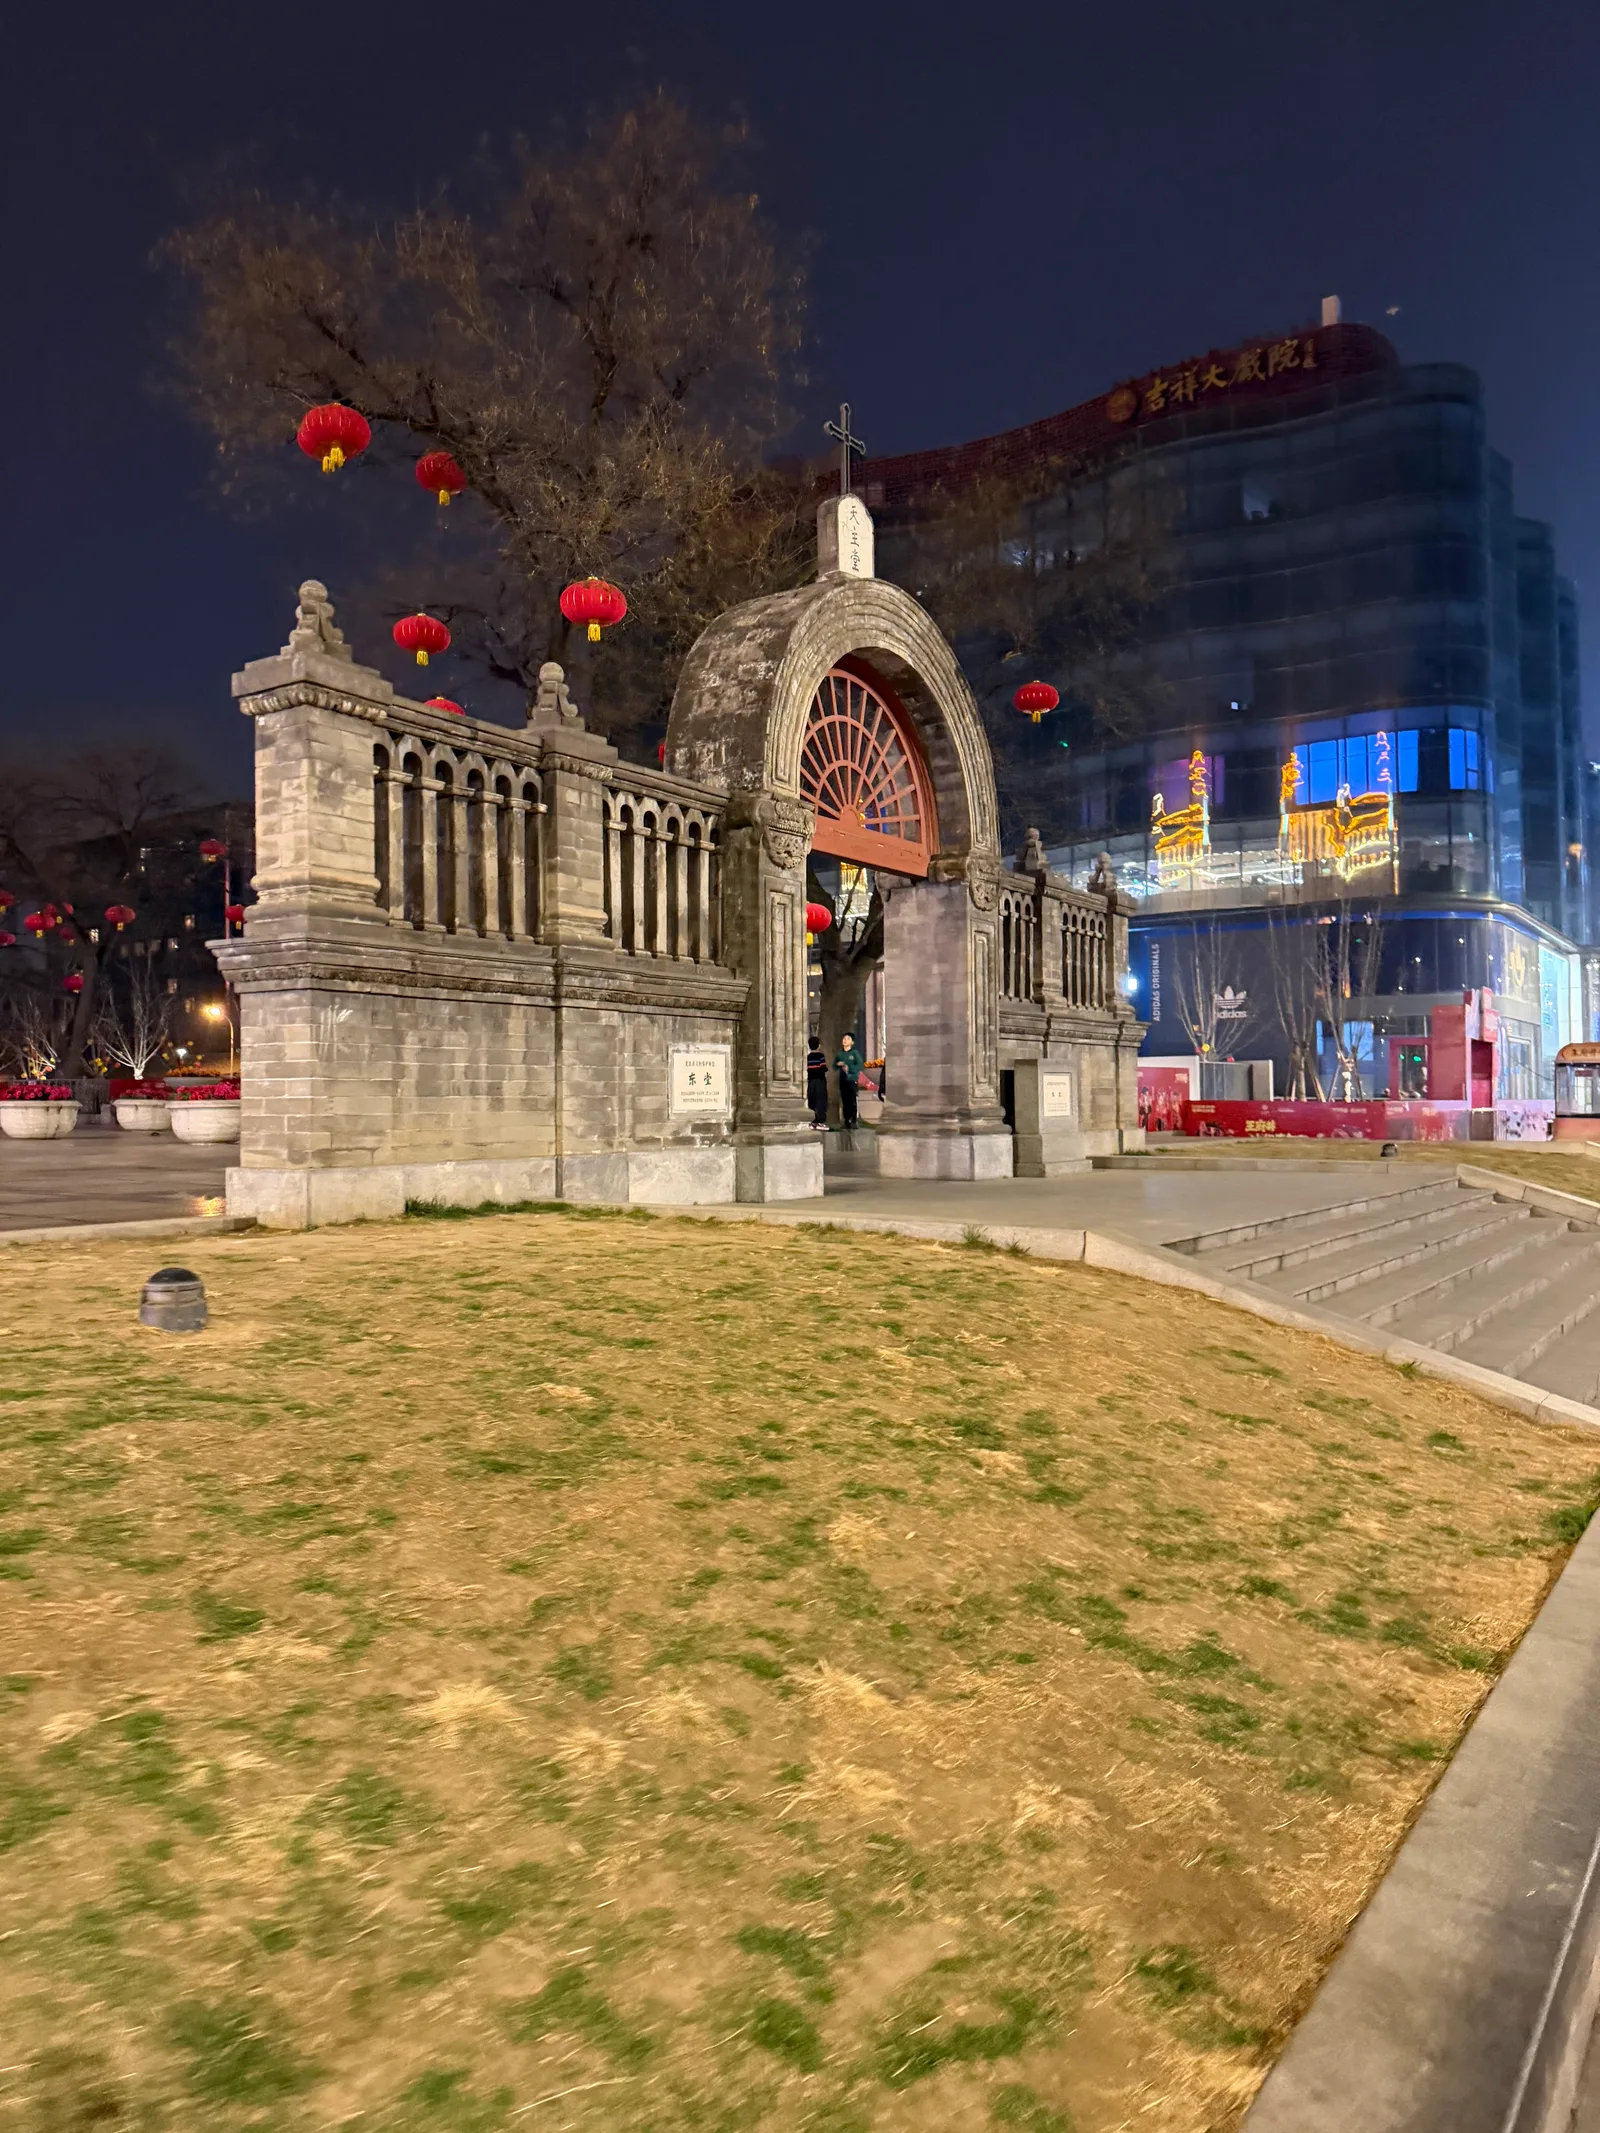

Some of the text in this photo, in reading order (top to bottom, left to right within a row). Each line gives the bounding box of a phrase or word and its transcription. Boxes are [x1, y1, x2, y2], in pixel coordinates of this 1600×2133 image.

[1151, 943, 1160, 1021] ADIDAS ORIGINALS
[688, 1072, 713, 1086] 东堂
